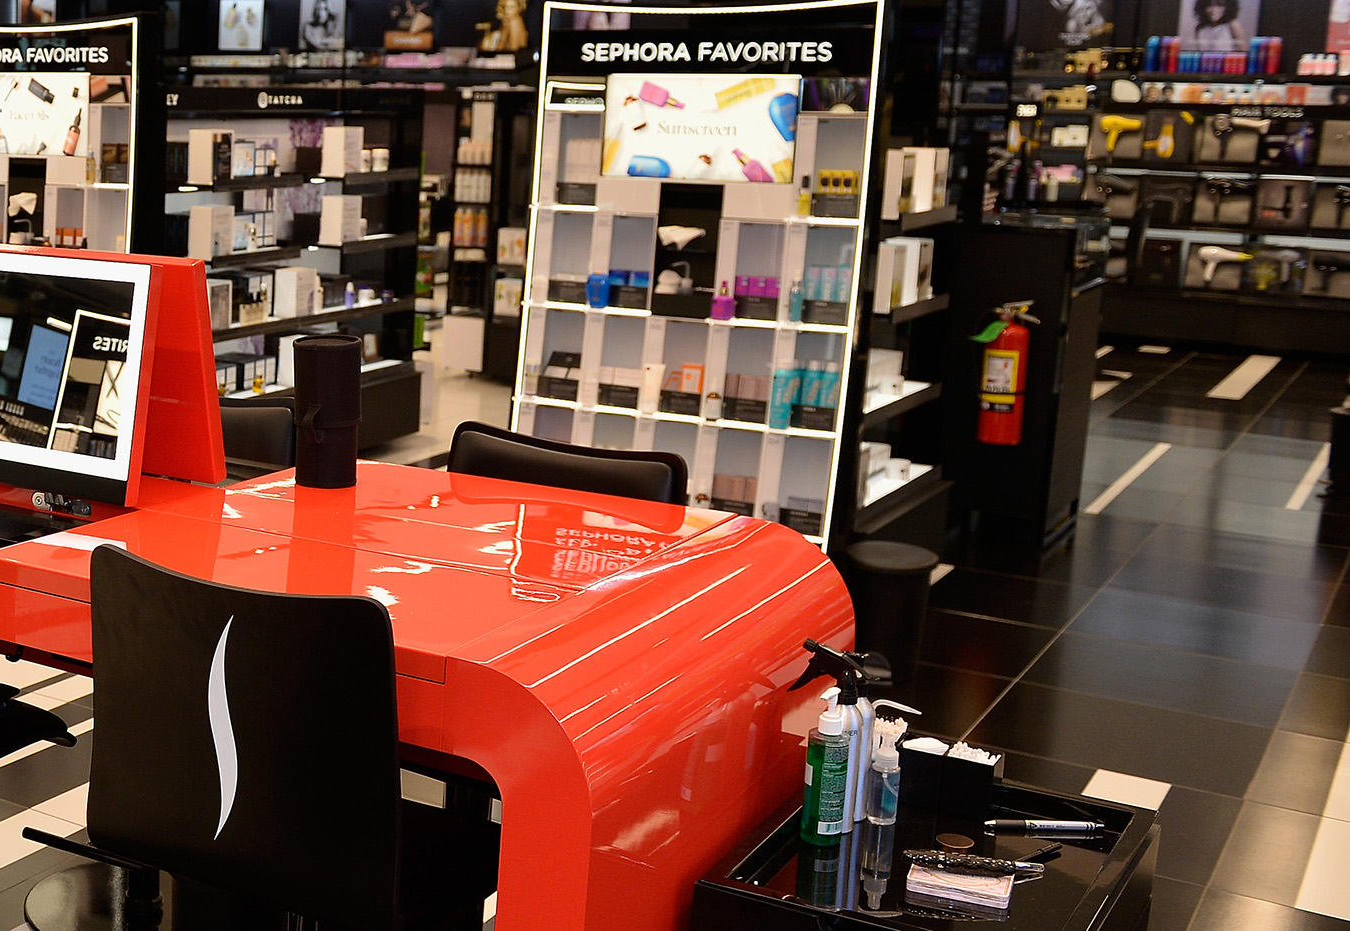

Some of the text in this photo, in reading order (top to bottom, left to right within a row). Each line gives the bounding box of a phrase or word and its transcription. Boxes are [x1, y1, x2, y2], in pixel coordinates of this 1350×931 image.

[26, 47, 109, 63] FAVORITES
[581, 41, 833, 63] SEPHORA FAVORITES
[268, 95, 303, 105] TATCHA
[657, 120, 738, 136] Sunscreen
